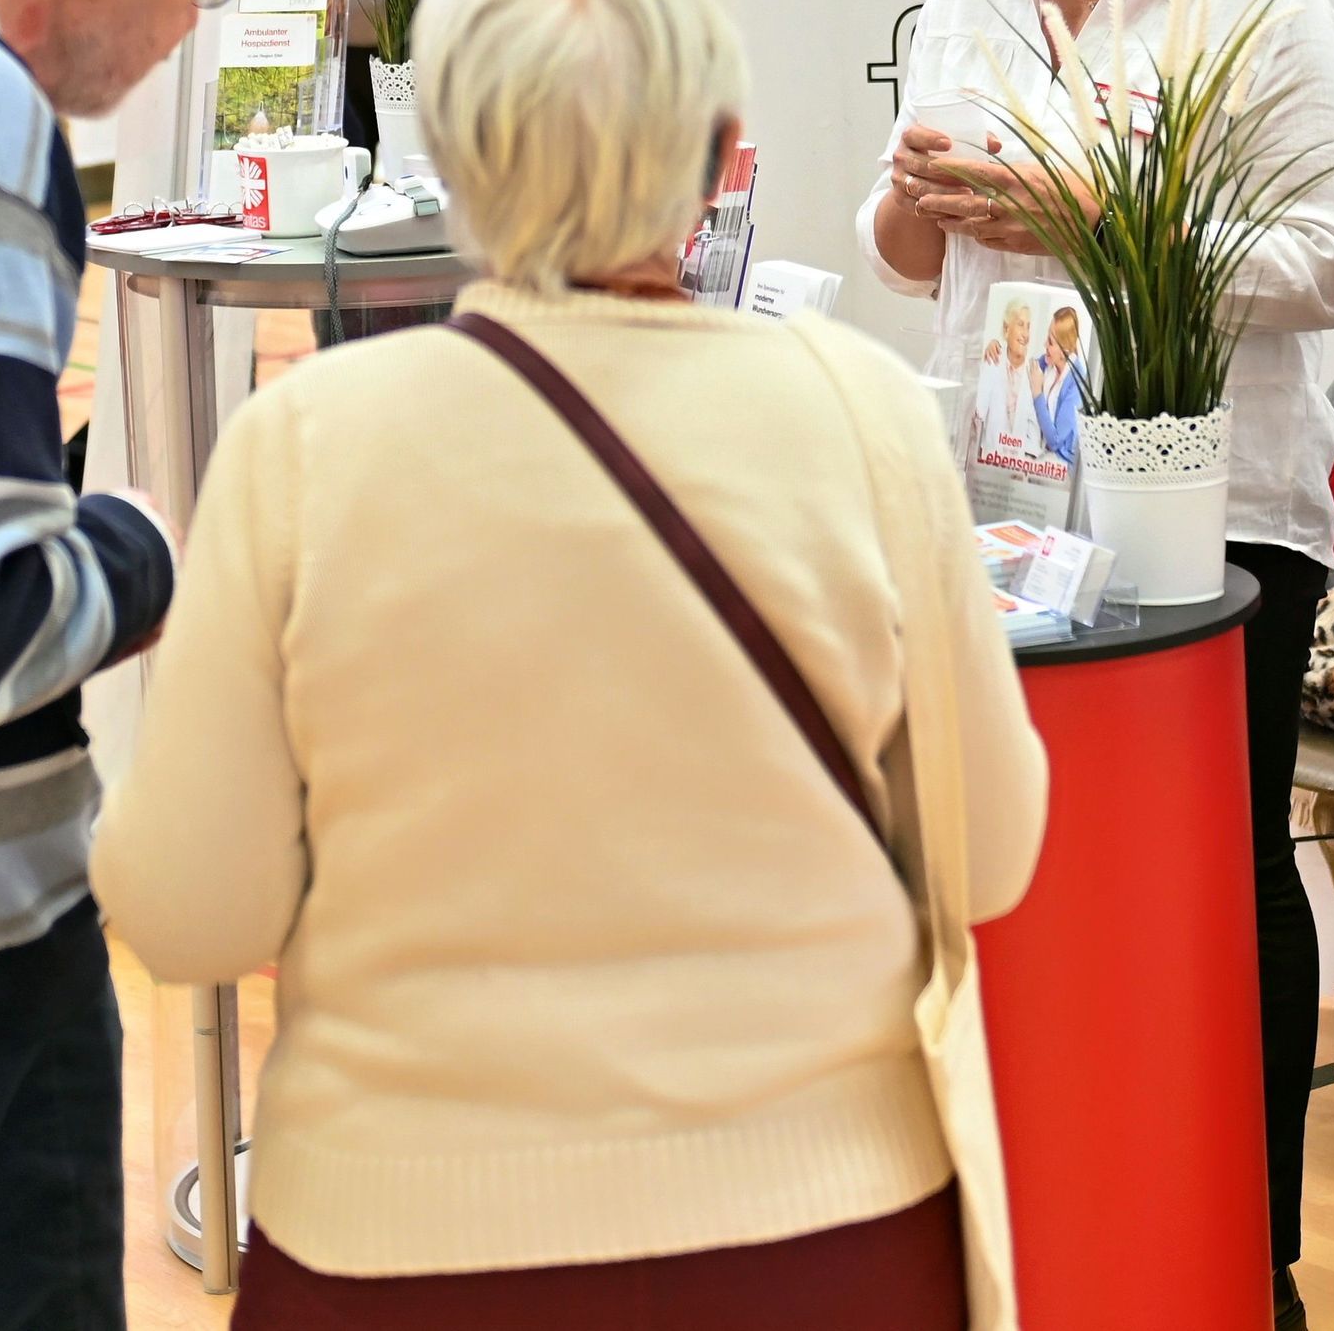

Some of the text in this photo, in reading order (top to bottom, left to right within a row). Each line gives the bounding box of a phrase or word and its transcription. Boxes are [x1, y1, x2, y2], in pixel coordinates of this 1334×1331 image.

[244, 28, 288, 37] Ambulanter
[241, 38, 291, 49] Hospizdienst
[998, 432, 1023, 448] Ideen
[977, 447, 1067, 481] Lebensqualität
